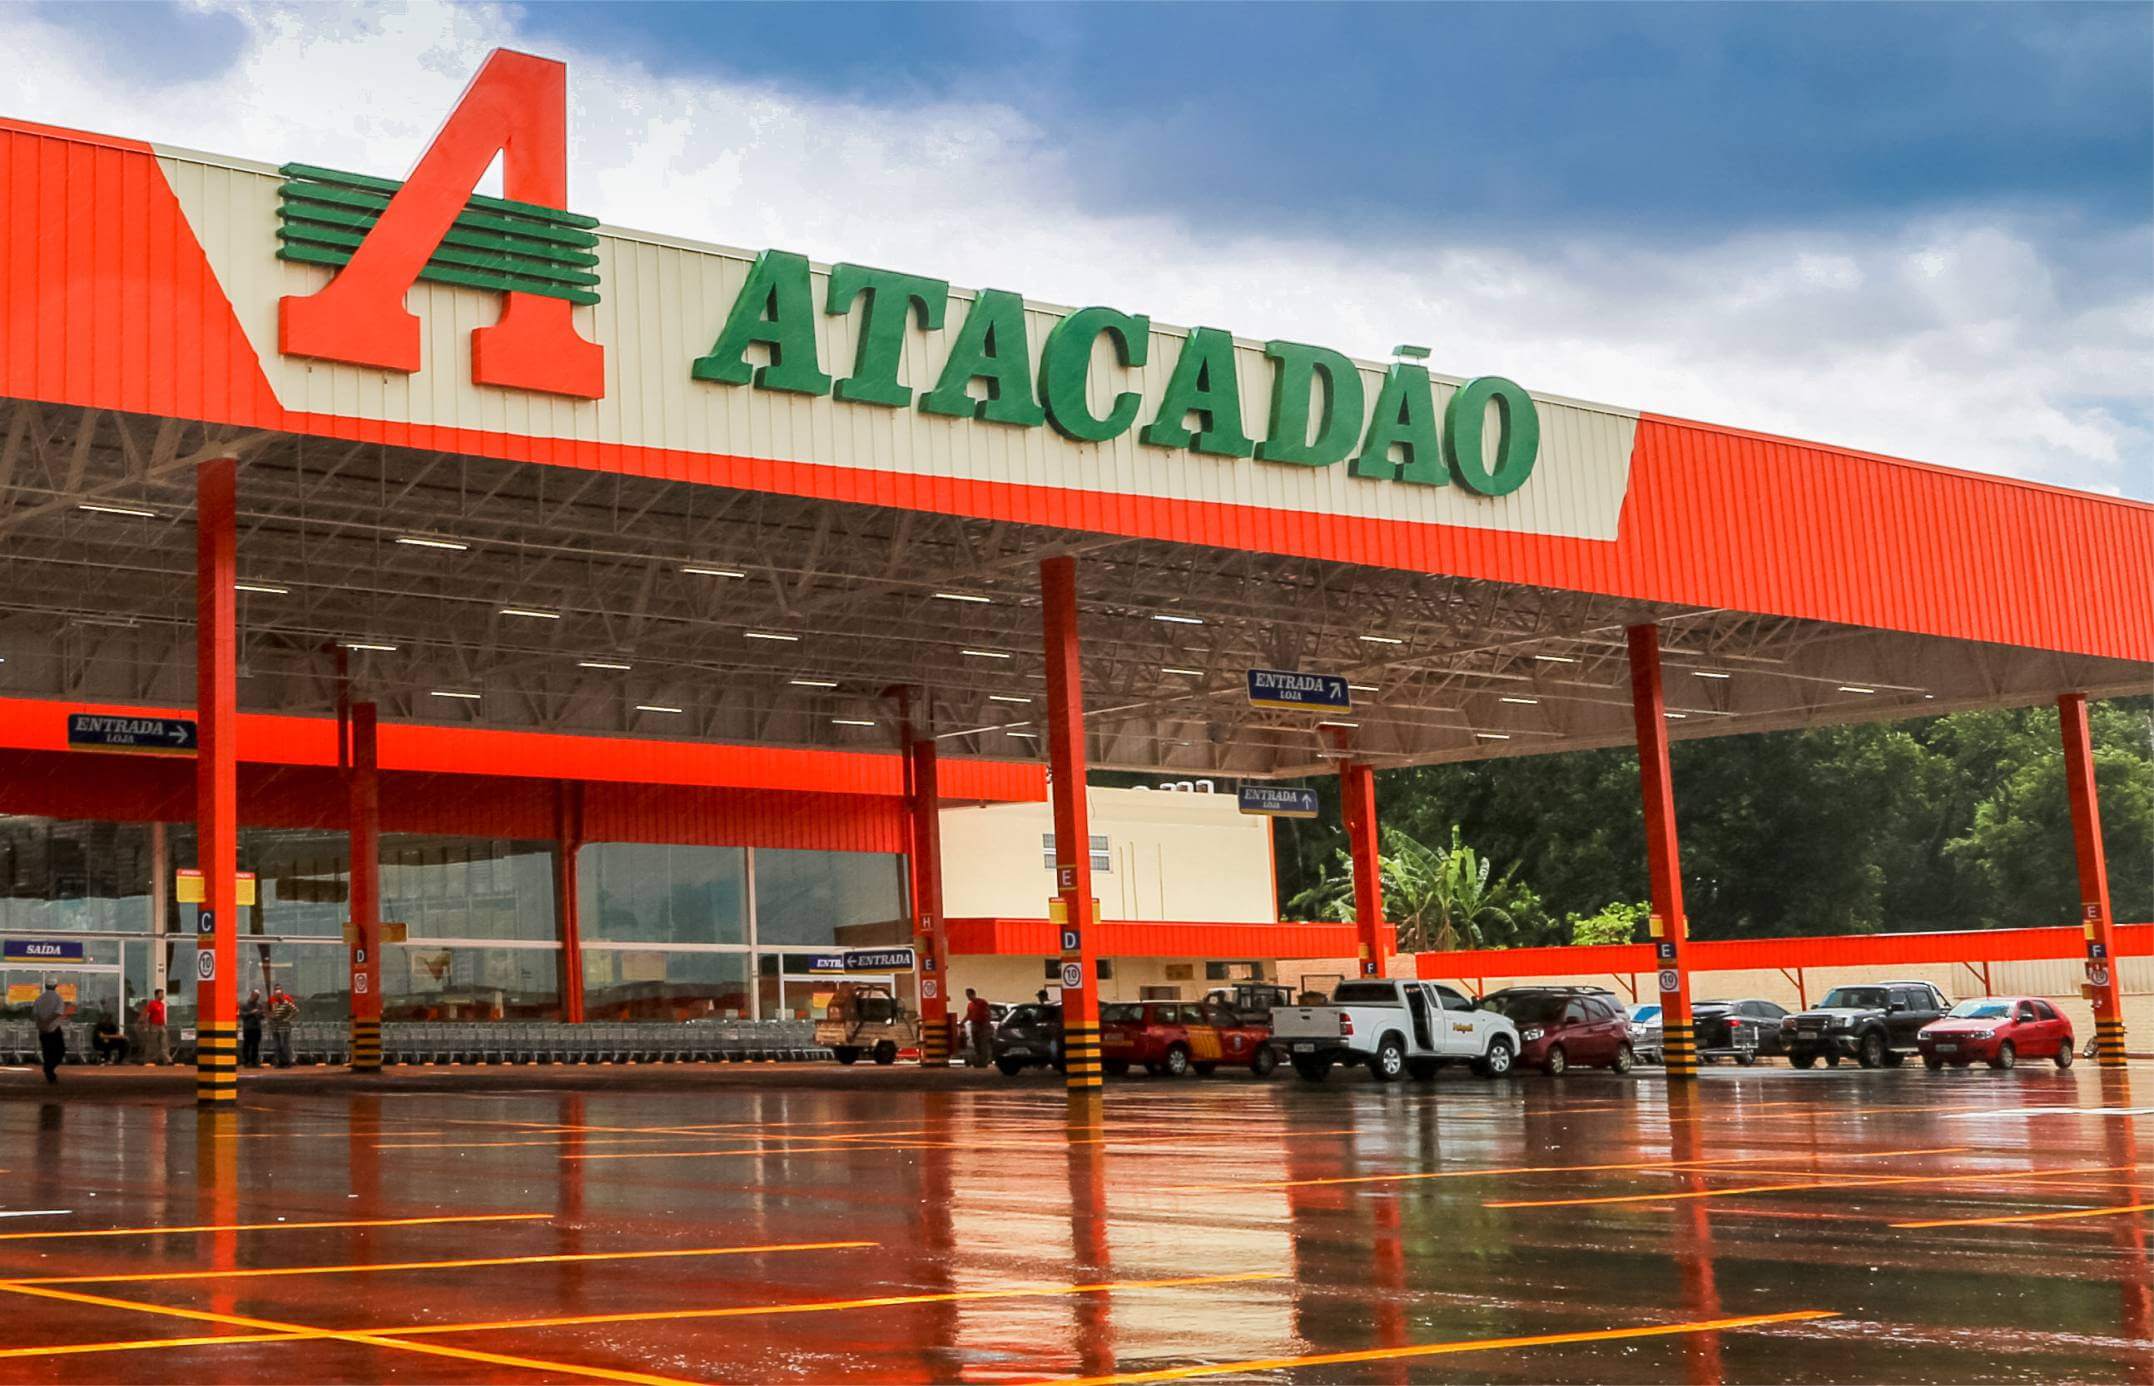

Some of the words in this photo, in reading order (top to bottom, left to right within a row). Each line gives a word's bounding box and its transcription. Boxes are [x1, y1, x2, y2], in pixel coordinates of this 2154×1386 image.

[691, 249, 1540, 498] ATACADÃO
[1255, 672, 1324, 692] ENTRADA
[1279, 690, 1302, 700] LOJA
[75, 717, 164, 735] ENTRADA
[106, 733, 135, 744] LOJA
[1244, 788, 1297, 803] ENTRADA
[1061, 870, 1072, 886] E
[2087, 905, 2097, 918] E
[201, 912, 212, 932] C
[922, 917, 931, 929] H
[1064, 932, 1077, 949] D
[26, 943, 62, 955] SAÍDA
[1661, 943, 1672, 958] E
[2092, 944, 2102, 957] F
[356, 949, 365, 963] D
[858, 954, 911, 967] ENTRADA
[925, 959, 932, 971] E
[1367, 962, 1374, 974] F
